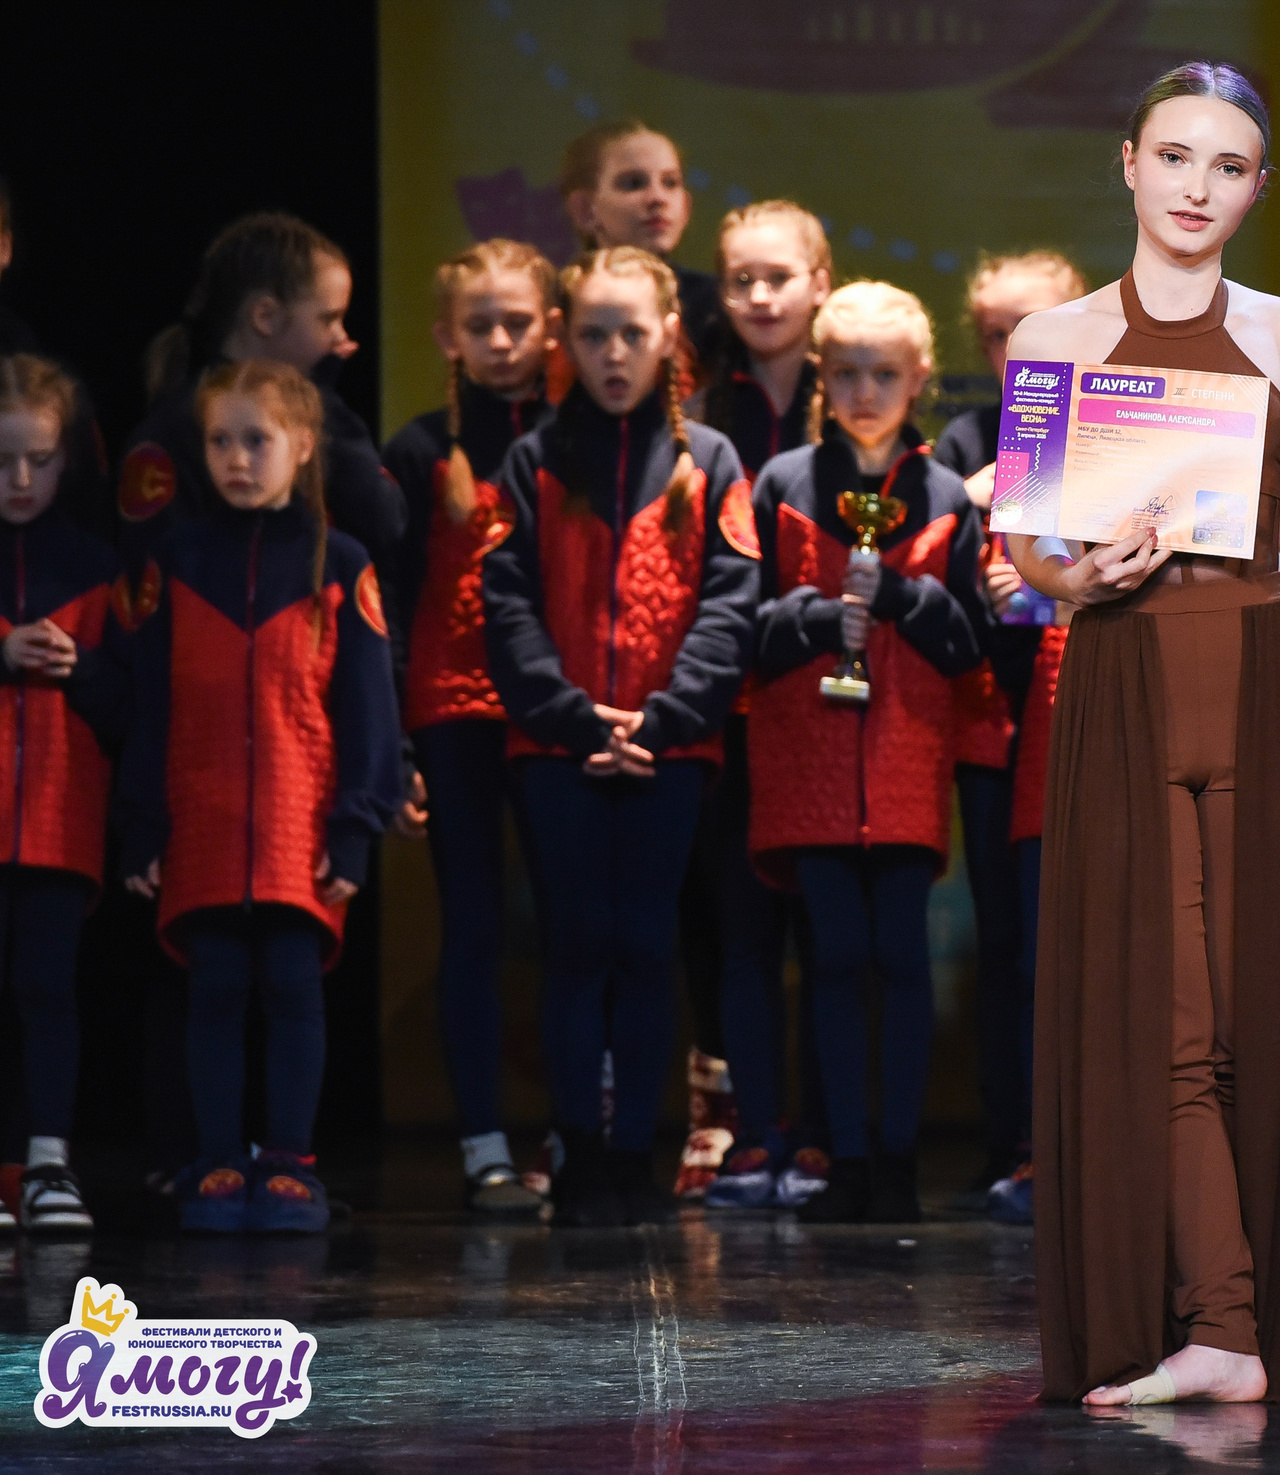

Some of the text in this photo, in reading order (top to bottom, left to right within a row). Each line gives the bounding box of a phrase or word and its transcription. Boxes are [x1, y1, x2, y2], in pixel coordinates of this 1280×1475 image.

[1090, 377, 1156, 394] ЛАУРЕАТ
[1191, 388, 1235, 401] СТЕПЕНИ
[1116, 409, 1216, 427] ЕЛЬЧАНИНОВА АЛЕКСАНДРА
